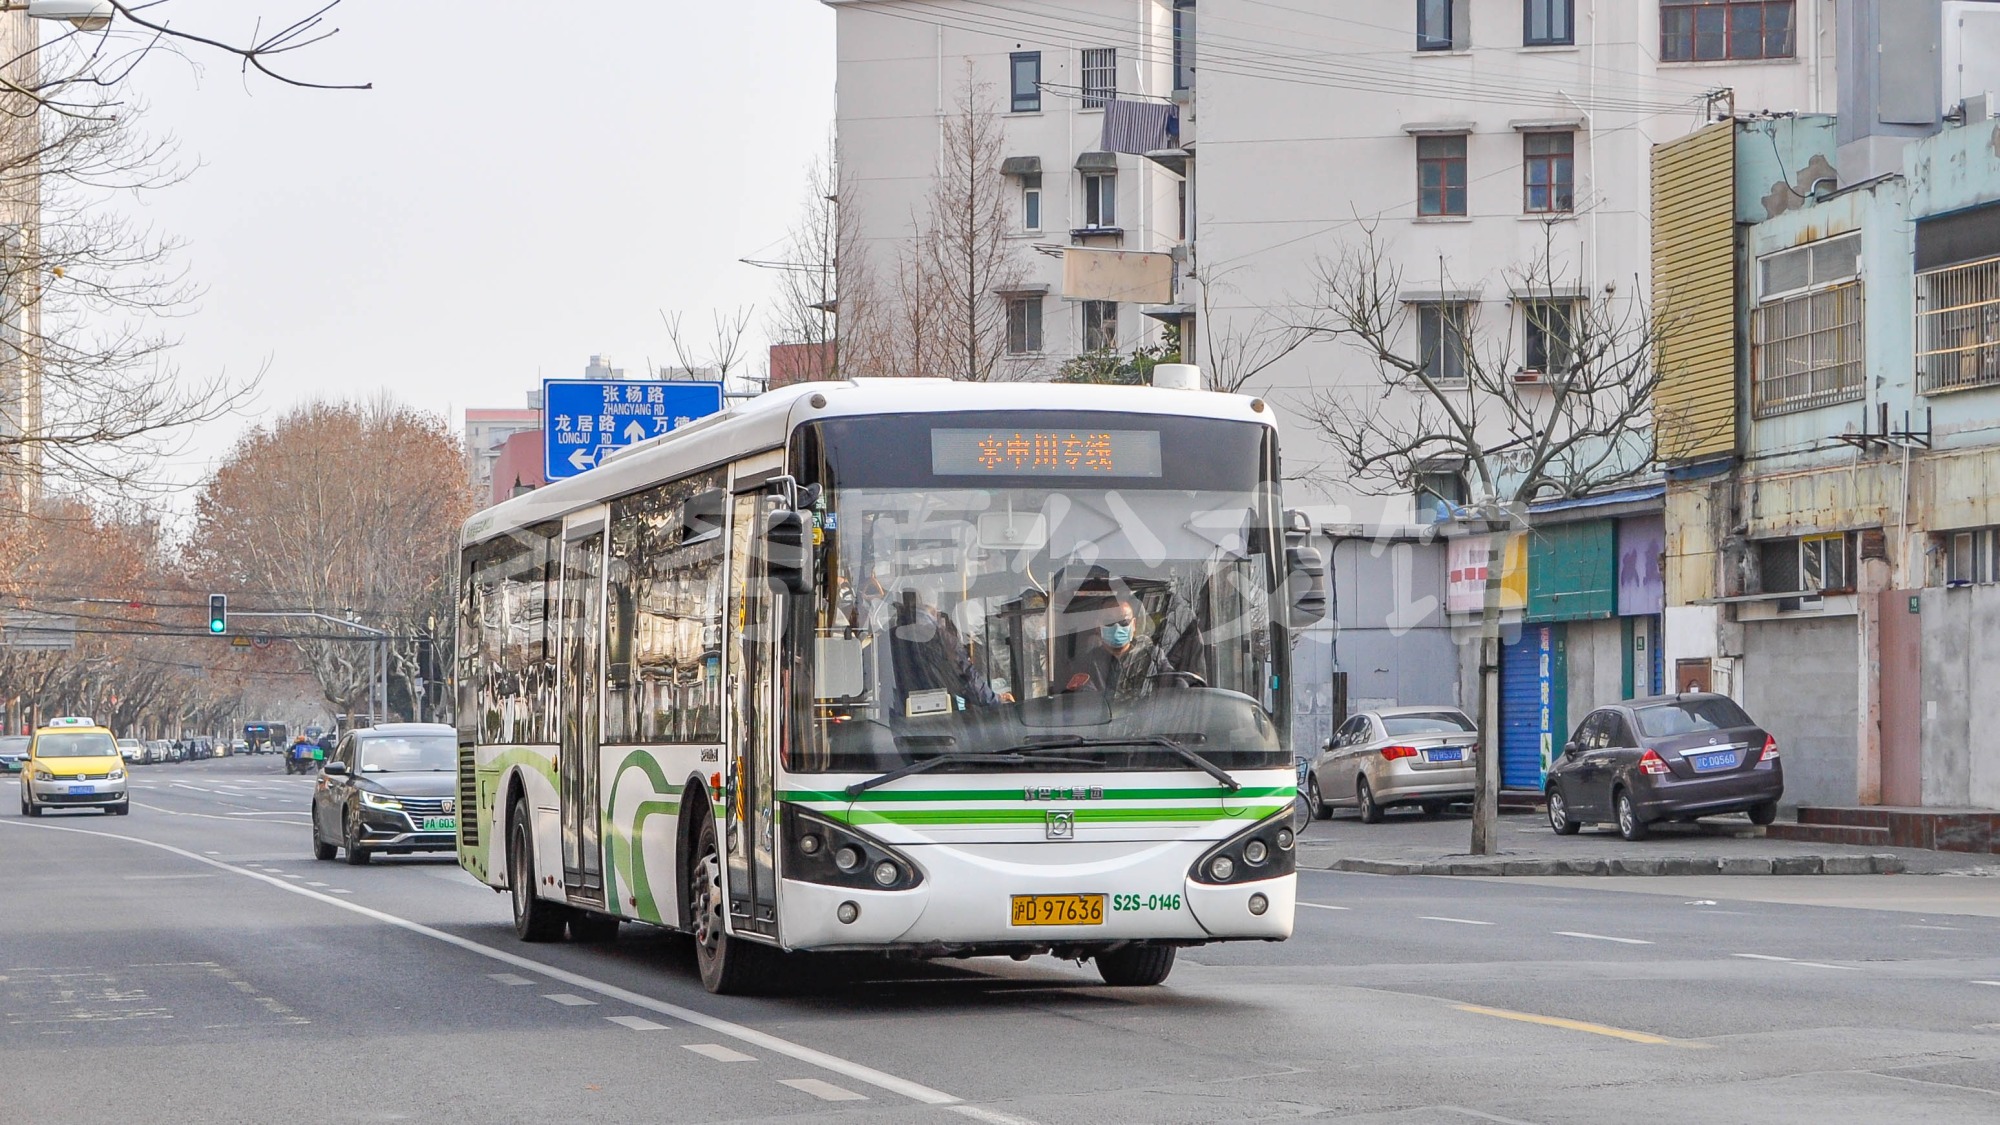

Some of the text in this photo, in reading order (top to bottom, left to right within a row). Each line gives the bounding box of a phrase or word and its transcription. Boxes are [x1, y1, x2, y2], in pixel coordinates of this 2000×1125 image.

[602, 385, 665, 403] 张杨路
[603, 403, 665, 416] ZHANGYANG RD
[554, 414, 616, 432] 龙居路
[558, 432, 612, 445] LONGJU RD
[1113, 893, 1181, 911] S2S-0146
